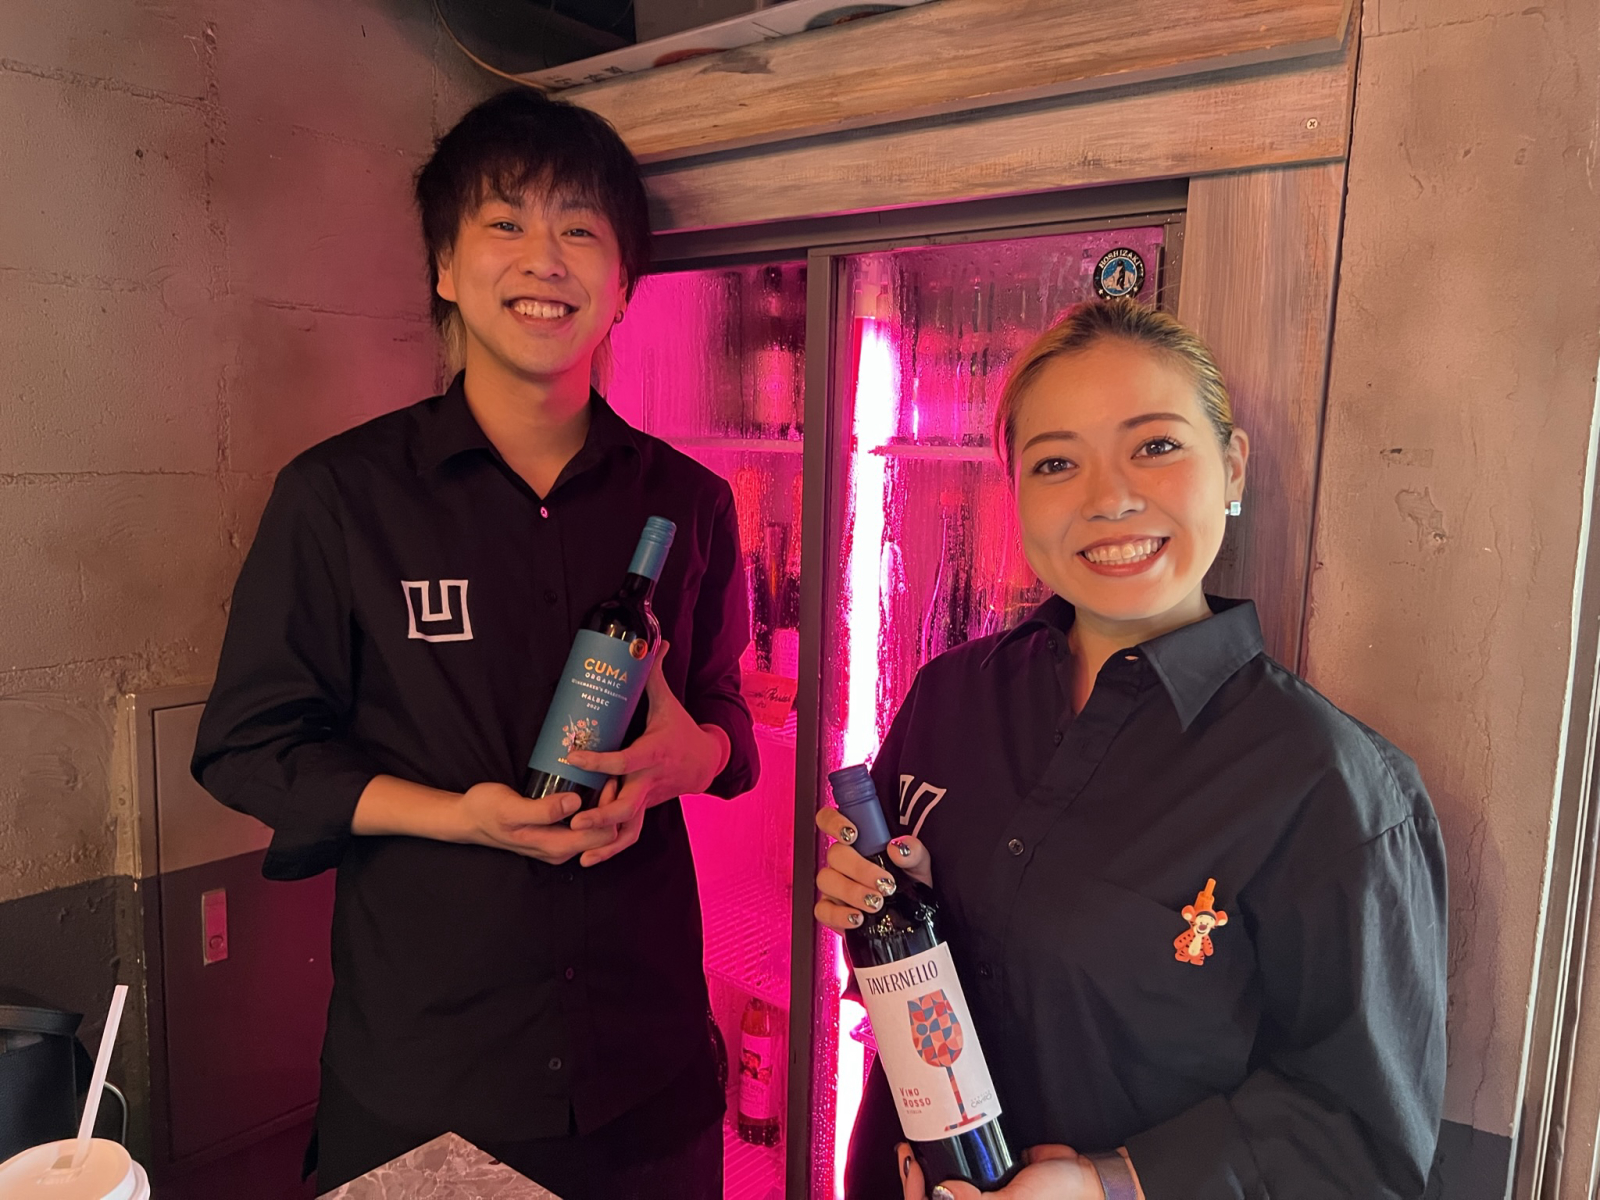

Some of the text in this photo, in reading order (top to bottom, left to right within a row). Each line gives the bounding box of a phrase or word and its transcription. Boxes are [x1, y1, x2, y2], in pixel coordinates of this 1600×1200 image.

[1098, 249, 1141, 269] HOSHIZAKI
[584, 658, 628, 684] CUMA
[584, 672, 621, 689] ORGANIC
[581, 692, 610, 707] MALBEC
[866, 960, 938, 995] TAVERNELLO
[902, 1097, 932, 1109] ROSSO
